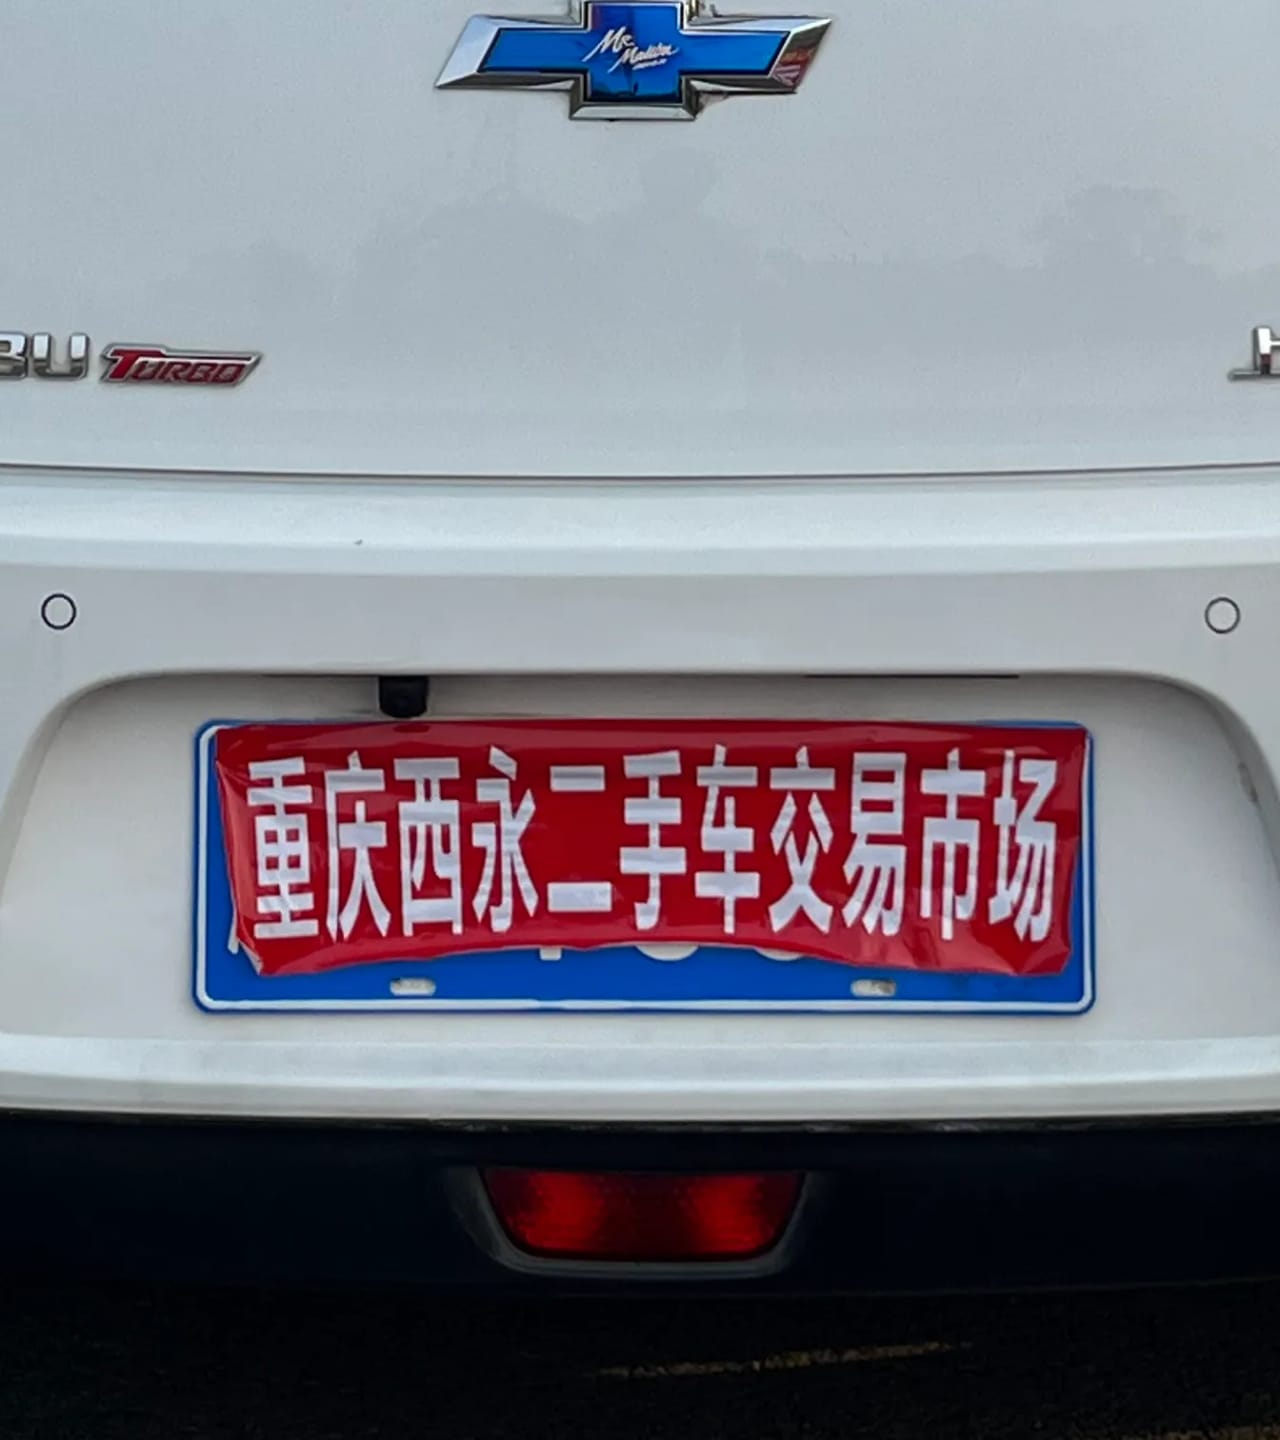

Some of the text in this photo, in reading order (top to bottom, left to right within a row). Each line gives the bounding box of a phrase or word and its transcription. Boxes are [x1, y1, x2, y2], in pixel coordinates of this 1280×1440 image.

[246, 744, 1059, 944] 重庆西永二手车交易市场
